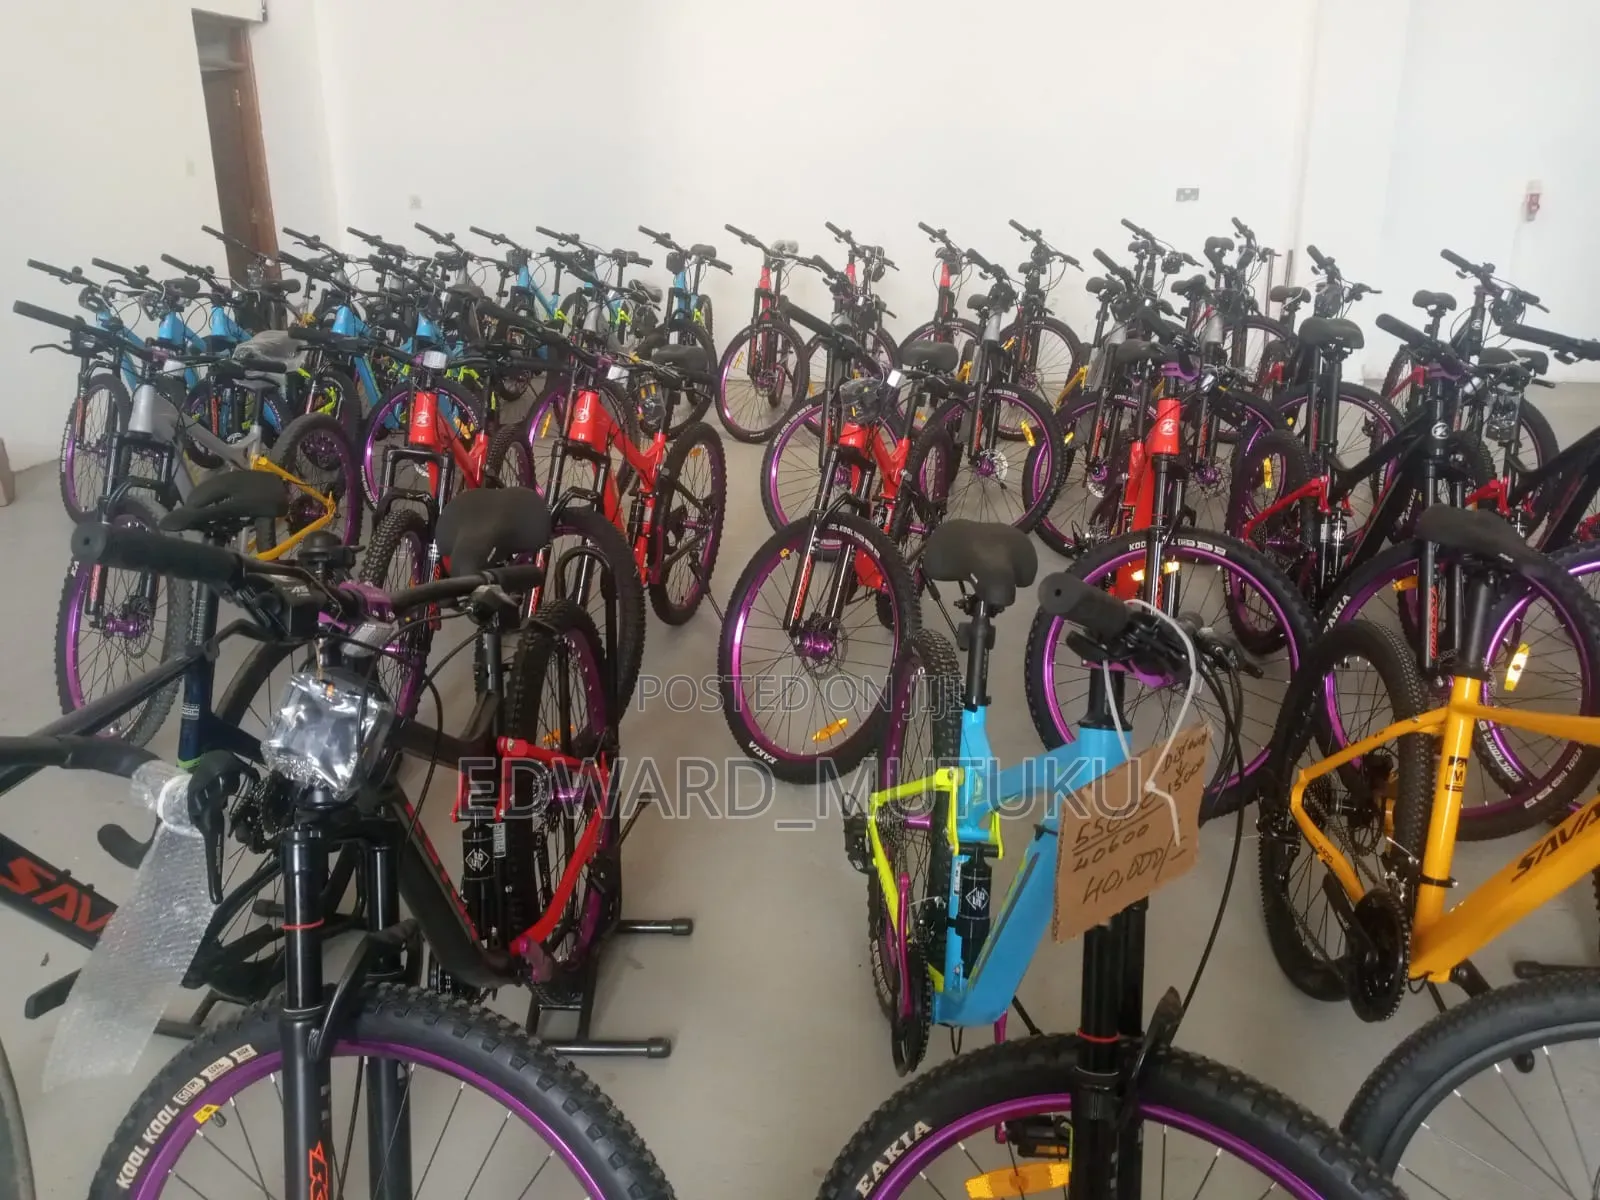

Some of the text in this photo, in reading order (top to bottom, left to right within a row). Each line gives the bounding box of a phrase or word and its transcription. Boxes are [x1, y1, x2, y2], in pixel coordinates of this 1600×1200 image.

[1128, 540, 1148, 552] KOO
[1073, 823, 1150, 872] 40600
[116, 1145, 150, 1189] KOOL
[142, 1104, 180, 1144] KOOL
[855, 1120, 933, 1199] EAKIA
